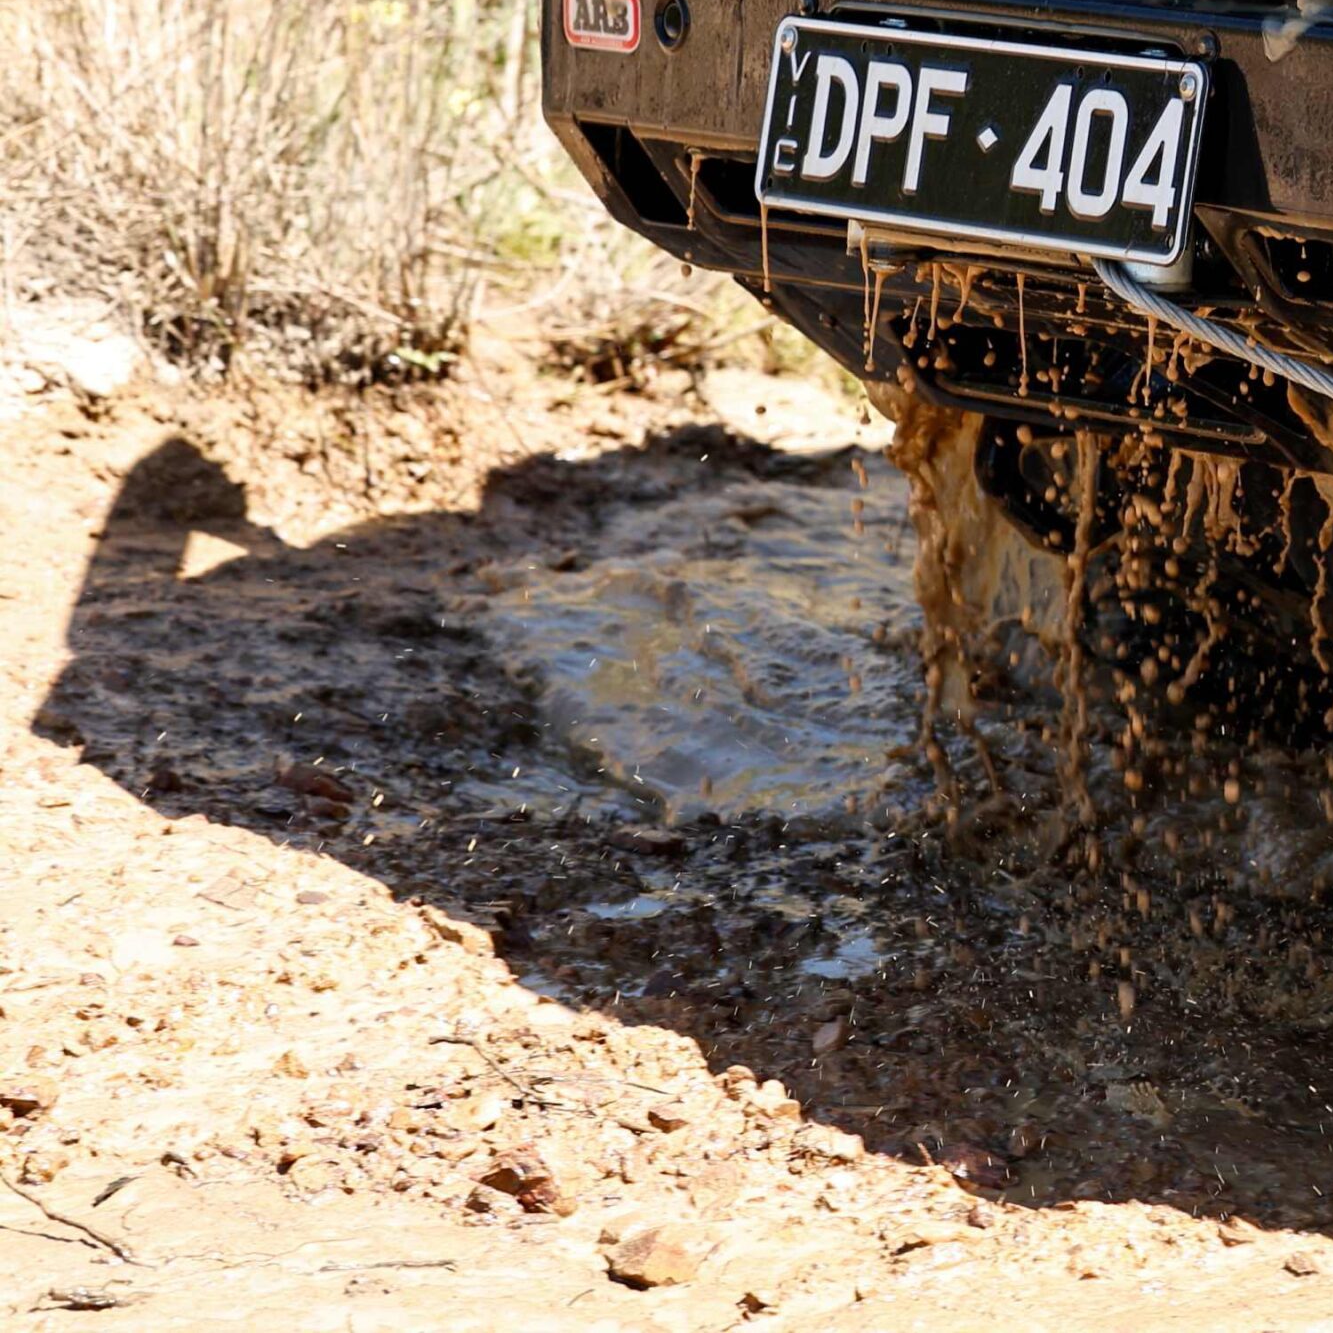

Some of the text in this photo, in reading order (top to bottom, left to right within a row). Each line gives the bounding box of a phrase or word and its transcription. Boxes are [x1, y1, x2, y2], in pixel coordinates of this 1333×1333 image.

[773, 50, 812, 174] VIC
[801, 55, 1185, 228] DPF 404
